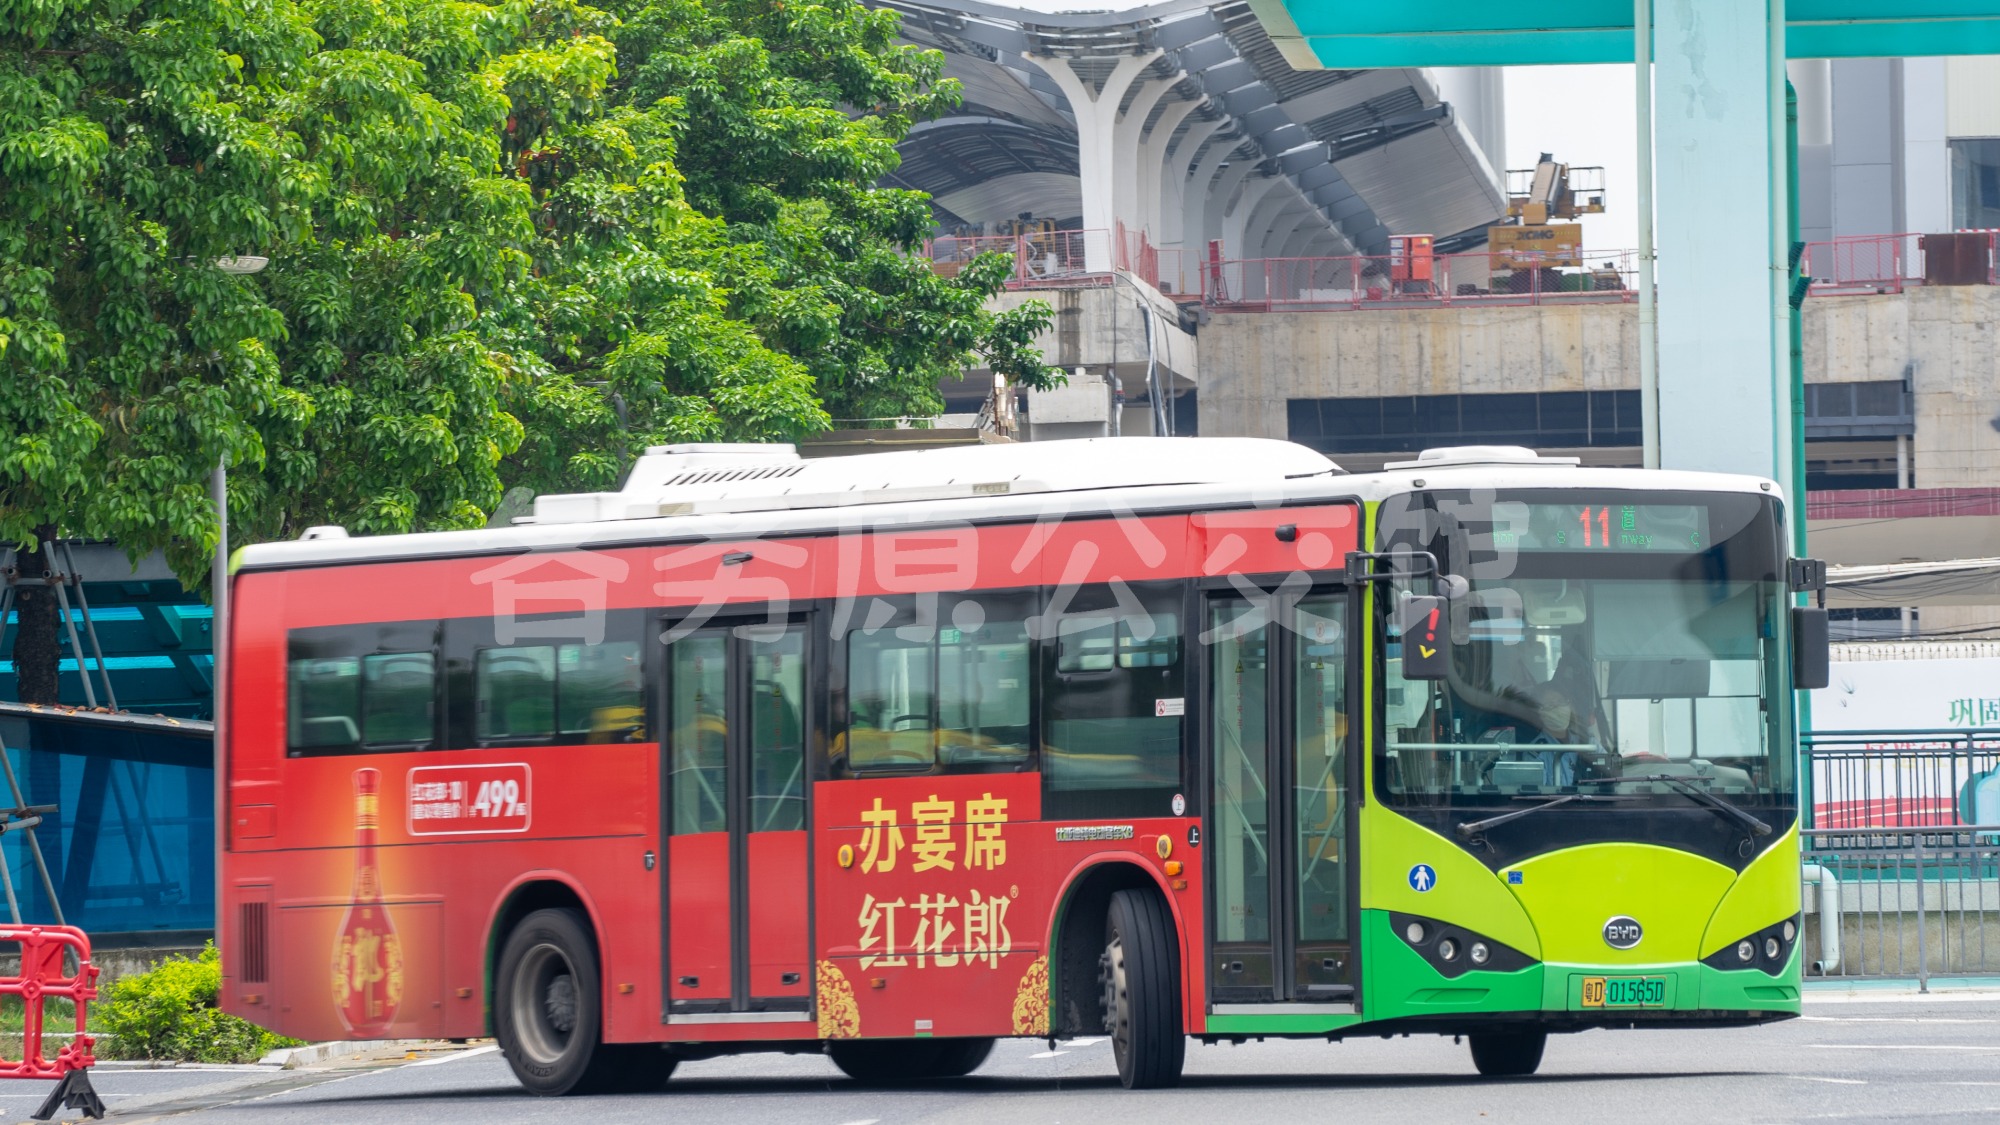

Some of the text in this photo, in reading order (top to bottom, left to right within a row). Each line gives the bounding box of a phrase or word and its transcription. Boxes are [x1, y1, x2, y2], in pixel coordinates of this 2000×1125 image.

[1579, 506, 1609, 547] 11
[1948, 697, 2000, 727] 巩固
[859, 792, 1008, 875] 办宴席
[1189, 828, 1199, 843] 上
[858, 888, 1012, 971] 红花郎
[1608, 925, 1639, 940] BYD
